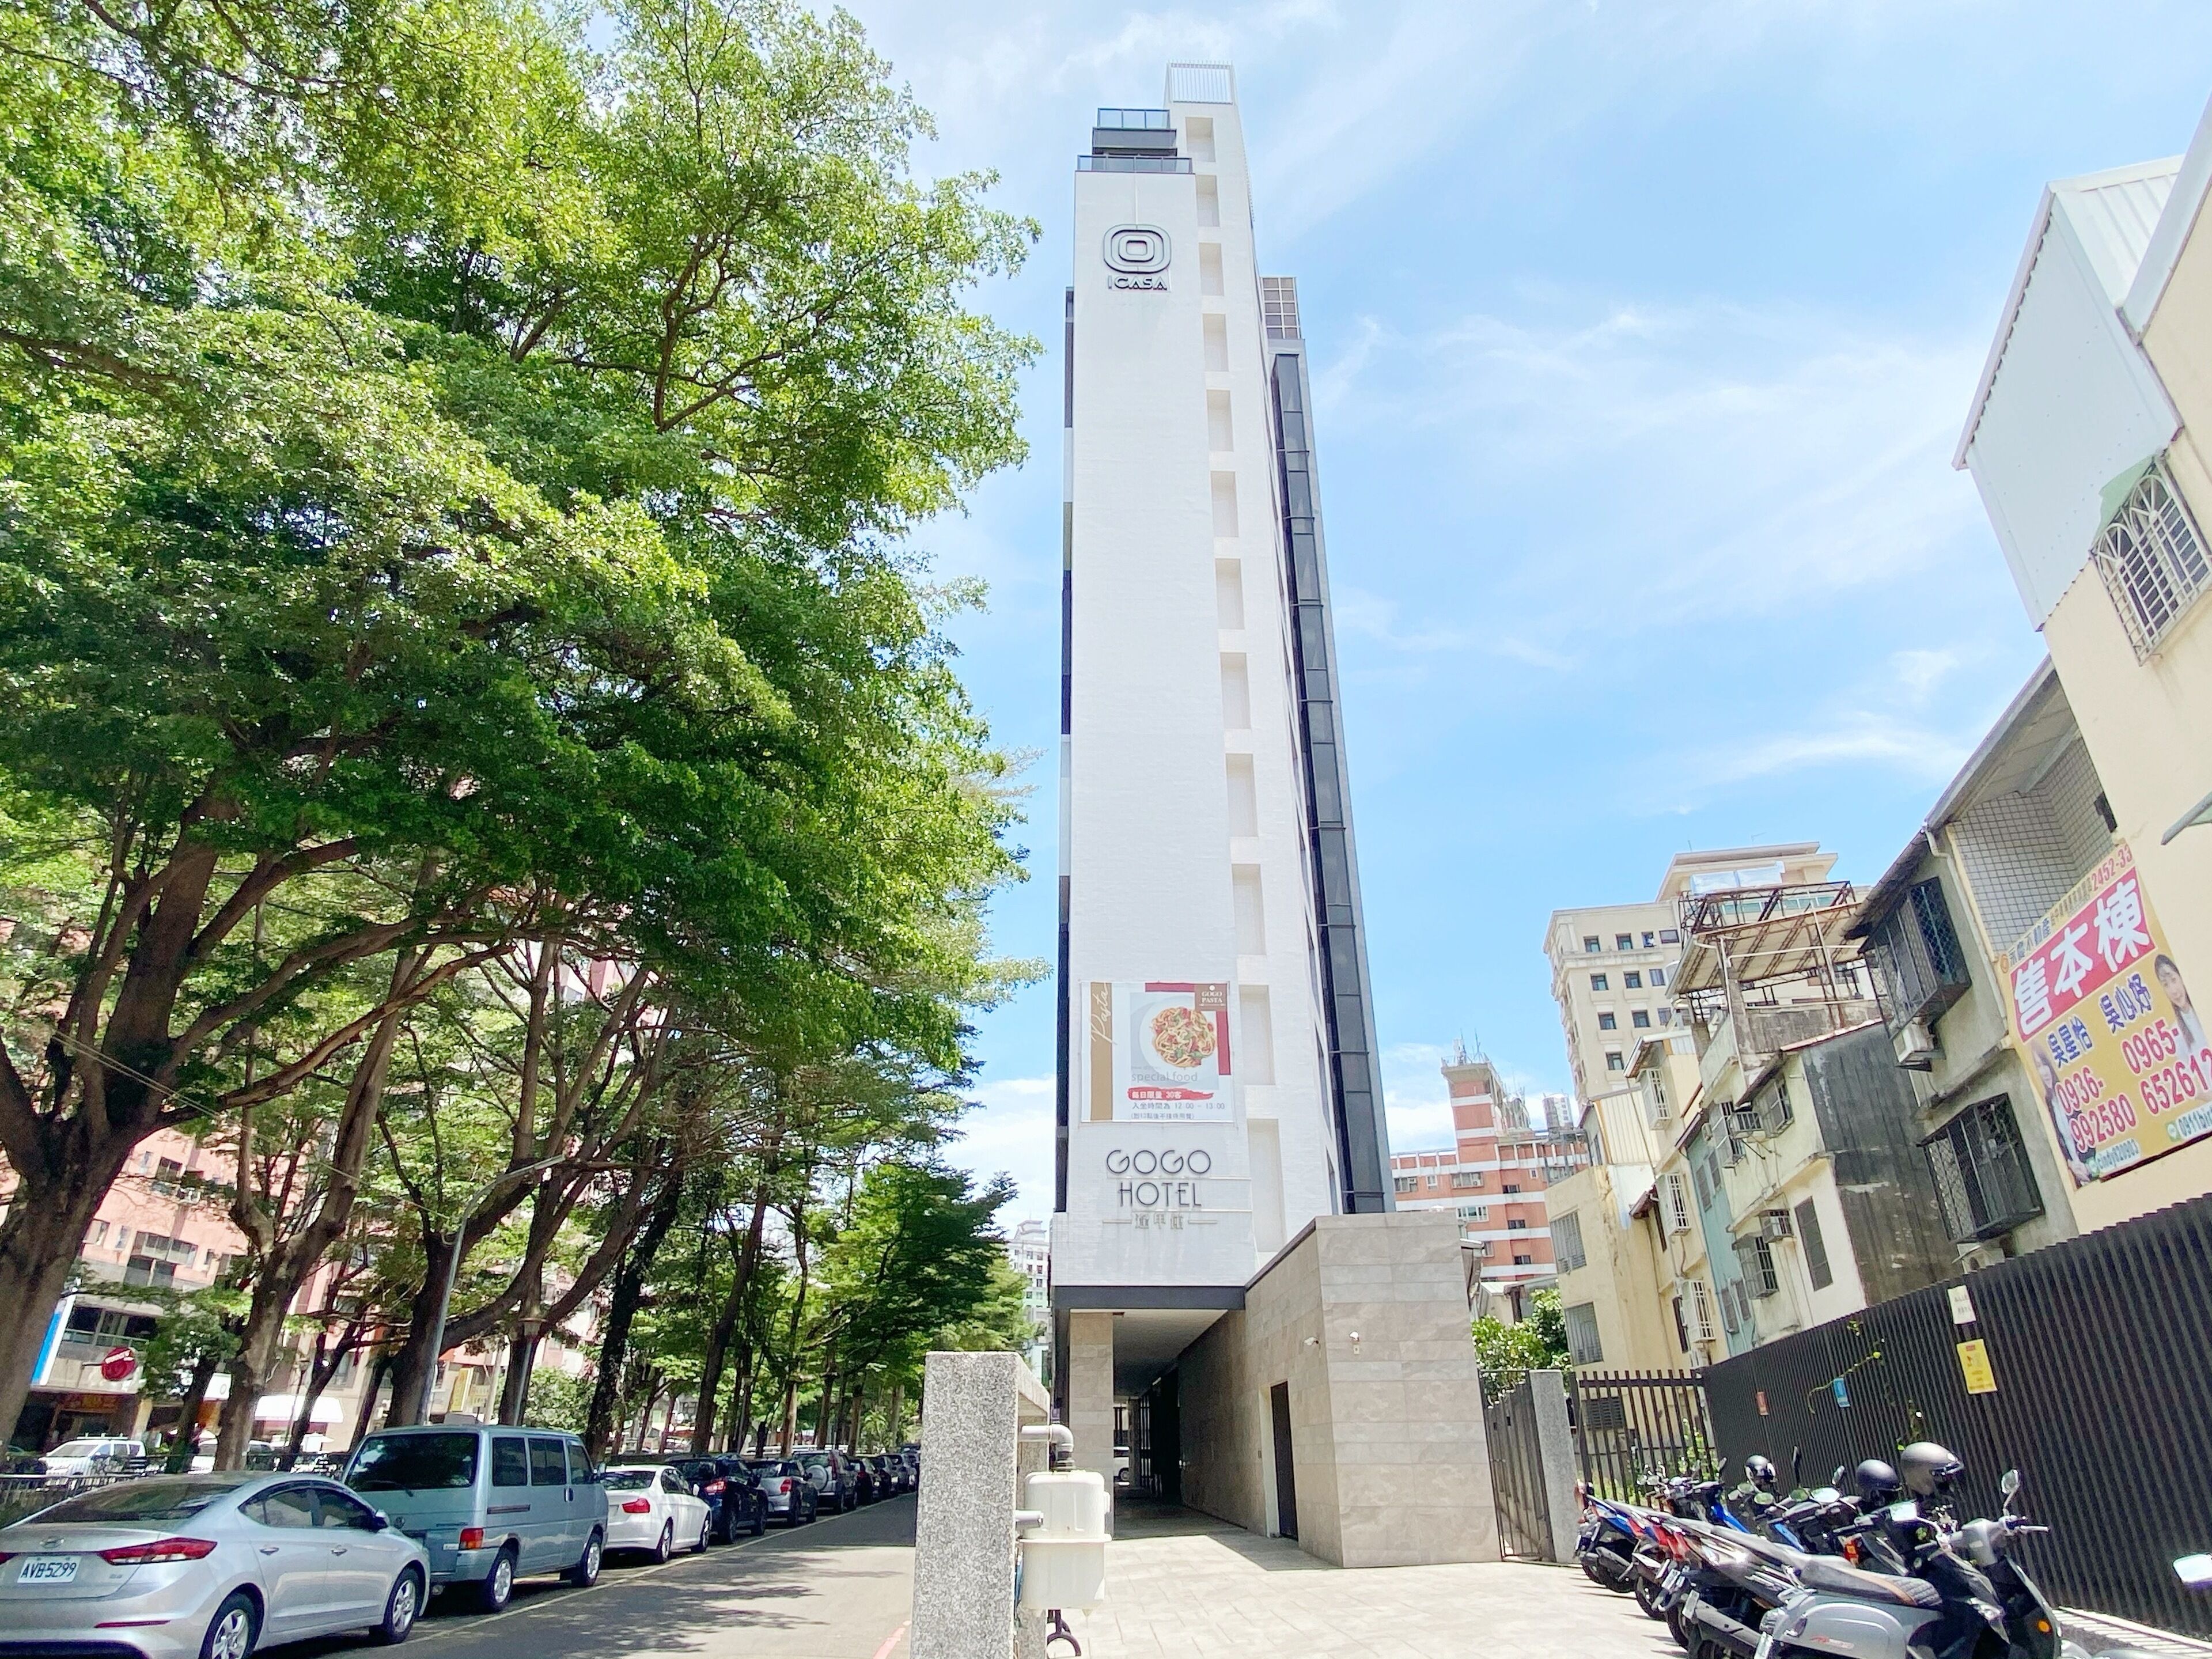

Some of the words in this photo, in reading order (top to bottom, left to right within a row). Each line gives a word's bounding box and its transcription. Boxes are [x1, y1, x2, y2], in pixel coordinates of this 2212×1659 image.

[2013, 877, 2150, 1037] 售本棟
[1089, 982, 1118, 1046] Pasta
[2122, 1019, 2179, 1074] 0965-
[1131, 1071, 1169, 1083] special
[1173, 1071, 1198, 1082] food
[2055, 1067, 2104, 1114] 0936-
[2070, 1094, 2137, 1151] 992580
[1106, 1150, 1211, 1174] GOGO
[1119, 1181, 1202, 1207] HOTEL
